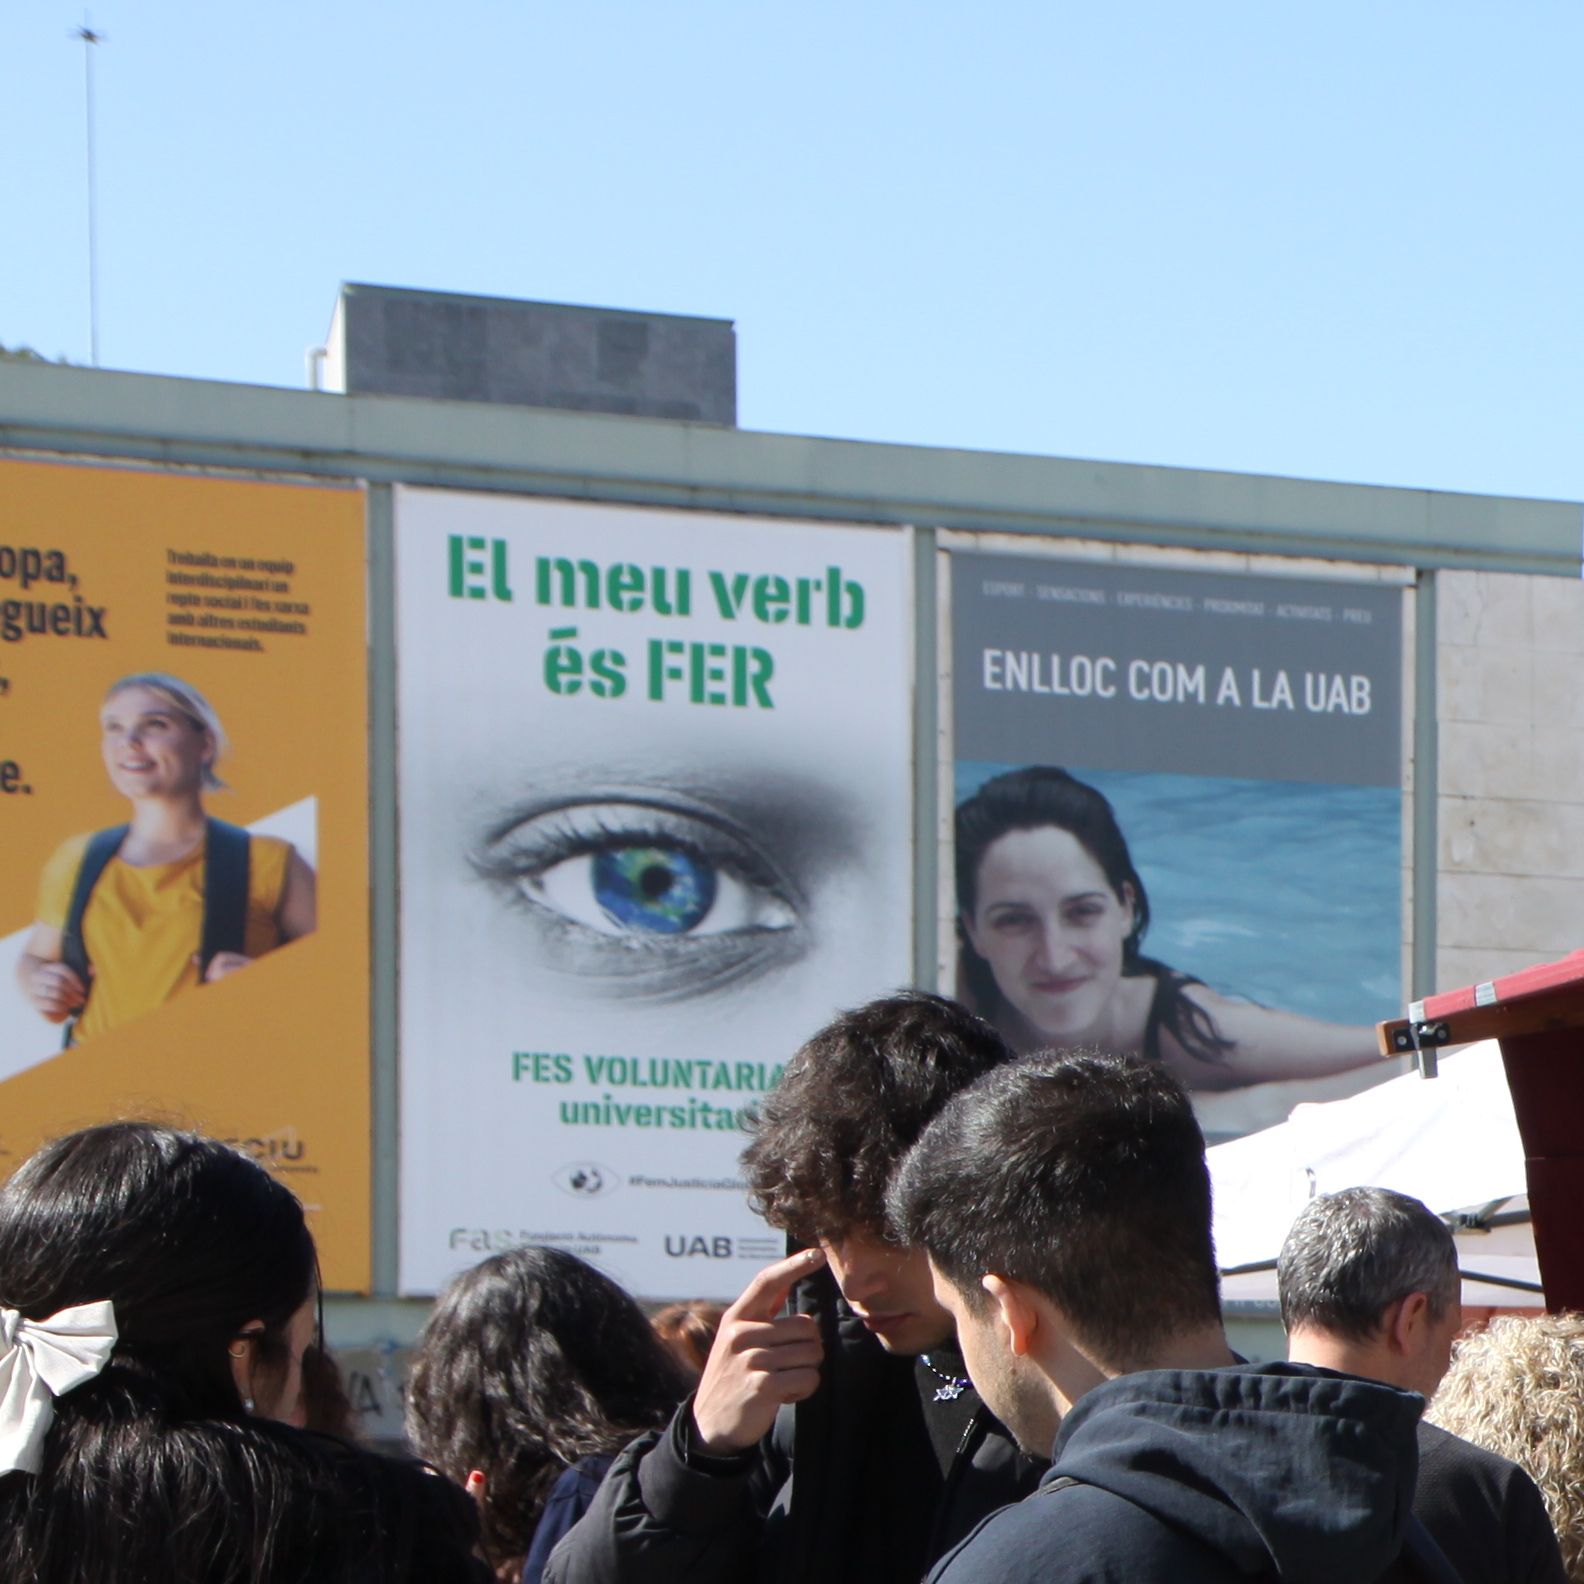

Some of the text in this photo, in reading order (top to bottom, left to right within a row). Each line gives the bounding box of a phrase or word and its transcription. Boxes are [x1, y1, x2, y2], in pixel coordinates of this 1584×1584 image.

[448, 534, 866, 631] El meu verb
[543, 626, 775, 709] és FER
[982, 648, 1372, 715] ENLLOC COM A LA UAB
[512, 1051, 573, 1084] FES
[560, 1093, 760, 1131] universita
[663, 1235, 733, 1259] UAB
